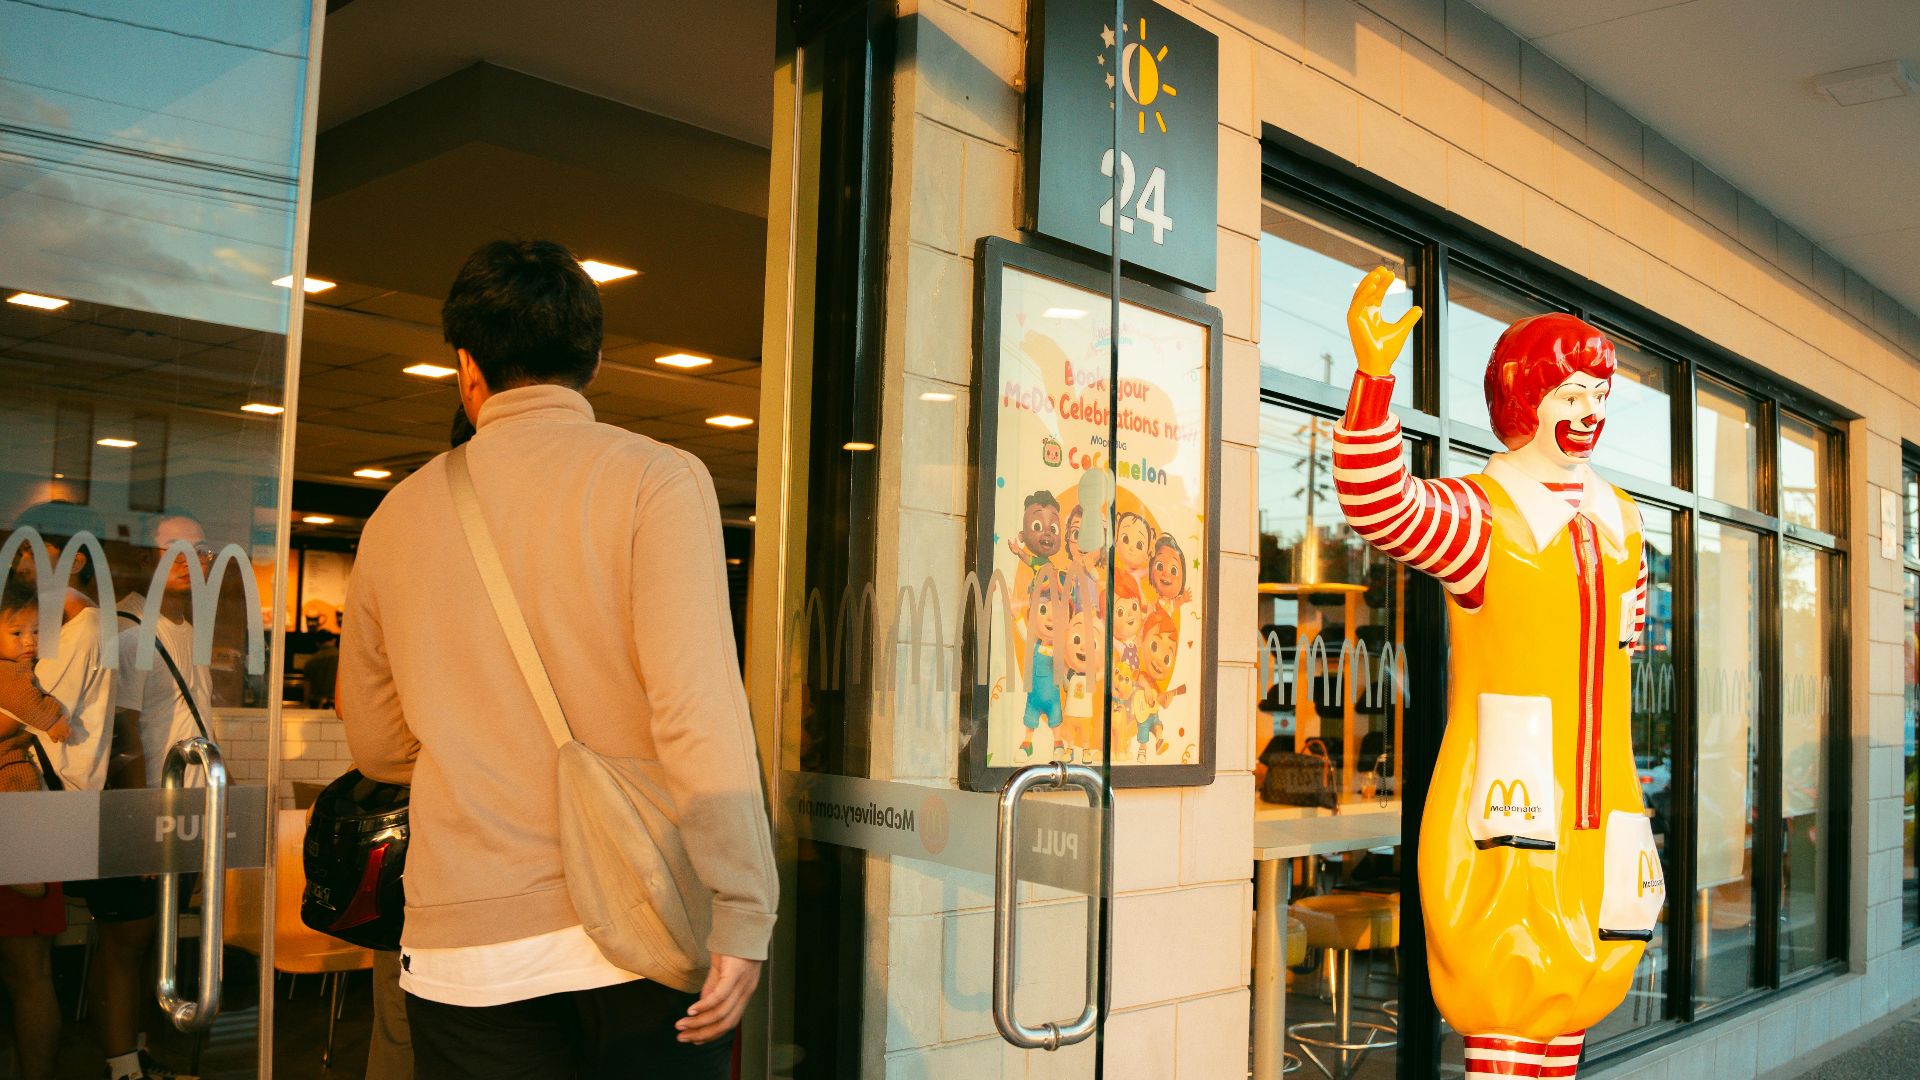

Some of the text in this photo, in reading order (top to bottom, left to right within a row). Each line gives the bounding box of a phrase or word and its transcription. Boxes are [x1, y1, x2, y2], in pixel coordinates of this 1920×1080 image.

[1098, 147, 1174, 246] 24
[1059, 393, 1160, 438] Celebrations
[154, 814, 237, 842] PU
